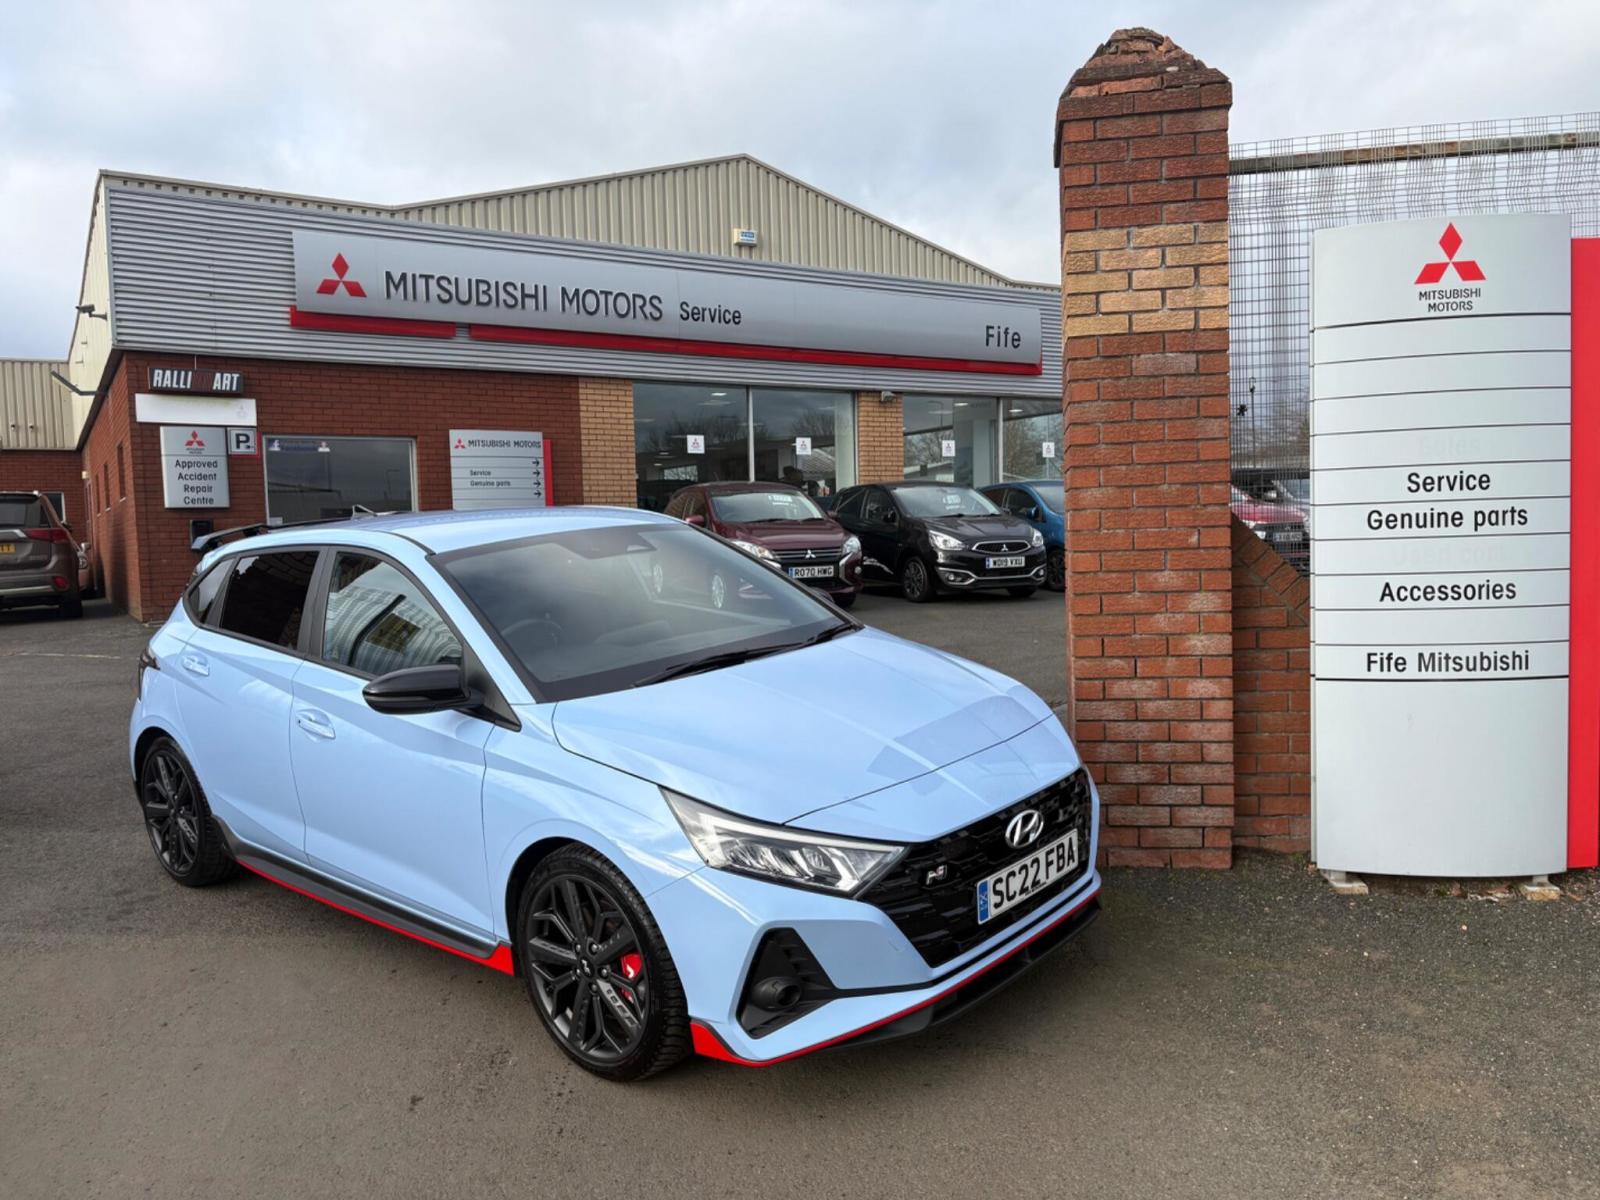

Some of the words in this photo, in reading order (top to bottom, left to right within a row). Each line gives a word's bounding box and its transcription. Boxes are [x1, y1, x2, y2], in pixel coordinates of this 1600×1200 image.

[385, 270, 548, 312] MITSUBISHI
[560, 286, 663, 321] MOTORS
[680, 301, 742, 325] Service
[1418, 288, 1481, 300] MITSUBISHI
[1428, 301, 1473, 312] MOTORS
[985, 325, 1021, 349] Fife
[153, 369, 193, 389] RALLI
[212, 372, 240, 391] ART
[235, 433, 250, 449] P
[468, 439, 511, 448] MITSUBISHI
[513, 440, 541, 449] MOTORS
[175, 459, 218, 469] Approved
[177, 472, 217, 481] Accident
[1407, 470, 1491, 493] Service
[183, 484, 213, 494] Repair
[183, 496, 214, 505] Centre
[1367, 507, 1464, 530] Genuine
[1474, 506, 1528, 532] parts
[1379, 579, 1517, 602] Accessories
[1366, 652, 1407, 672] Fife
[1417, 650, 1530, 672] Mitsubishi
[992, 857, 1041, 909] SC22
[1045, 837, 1075, 880] FBA
